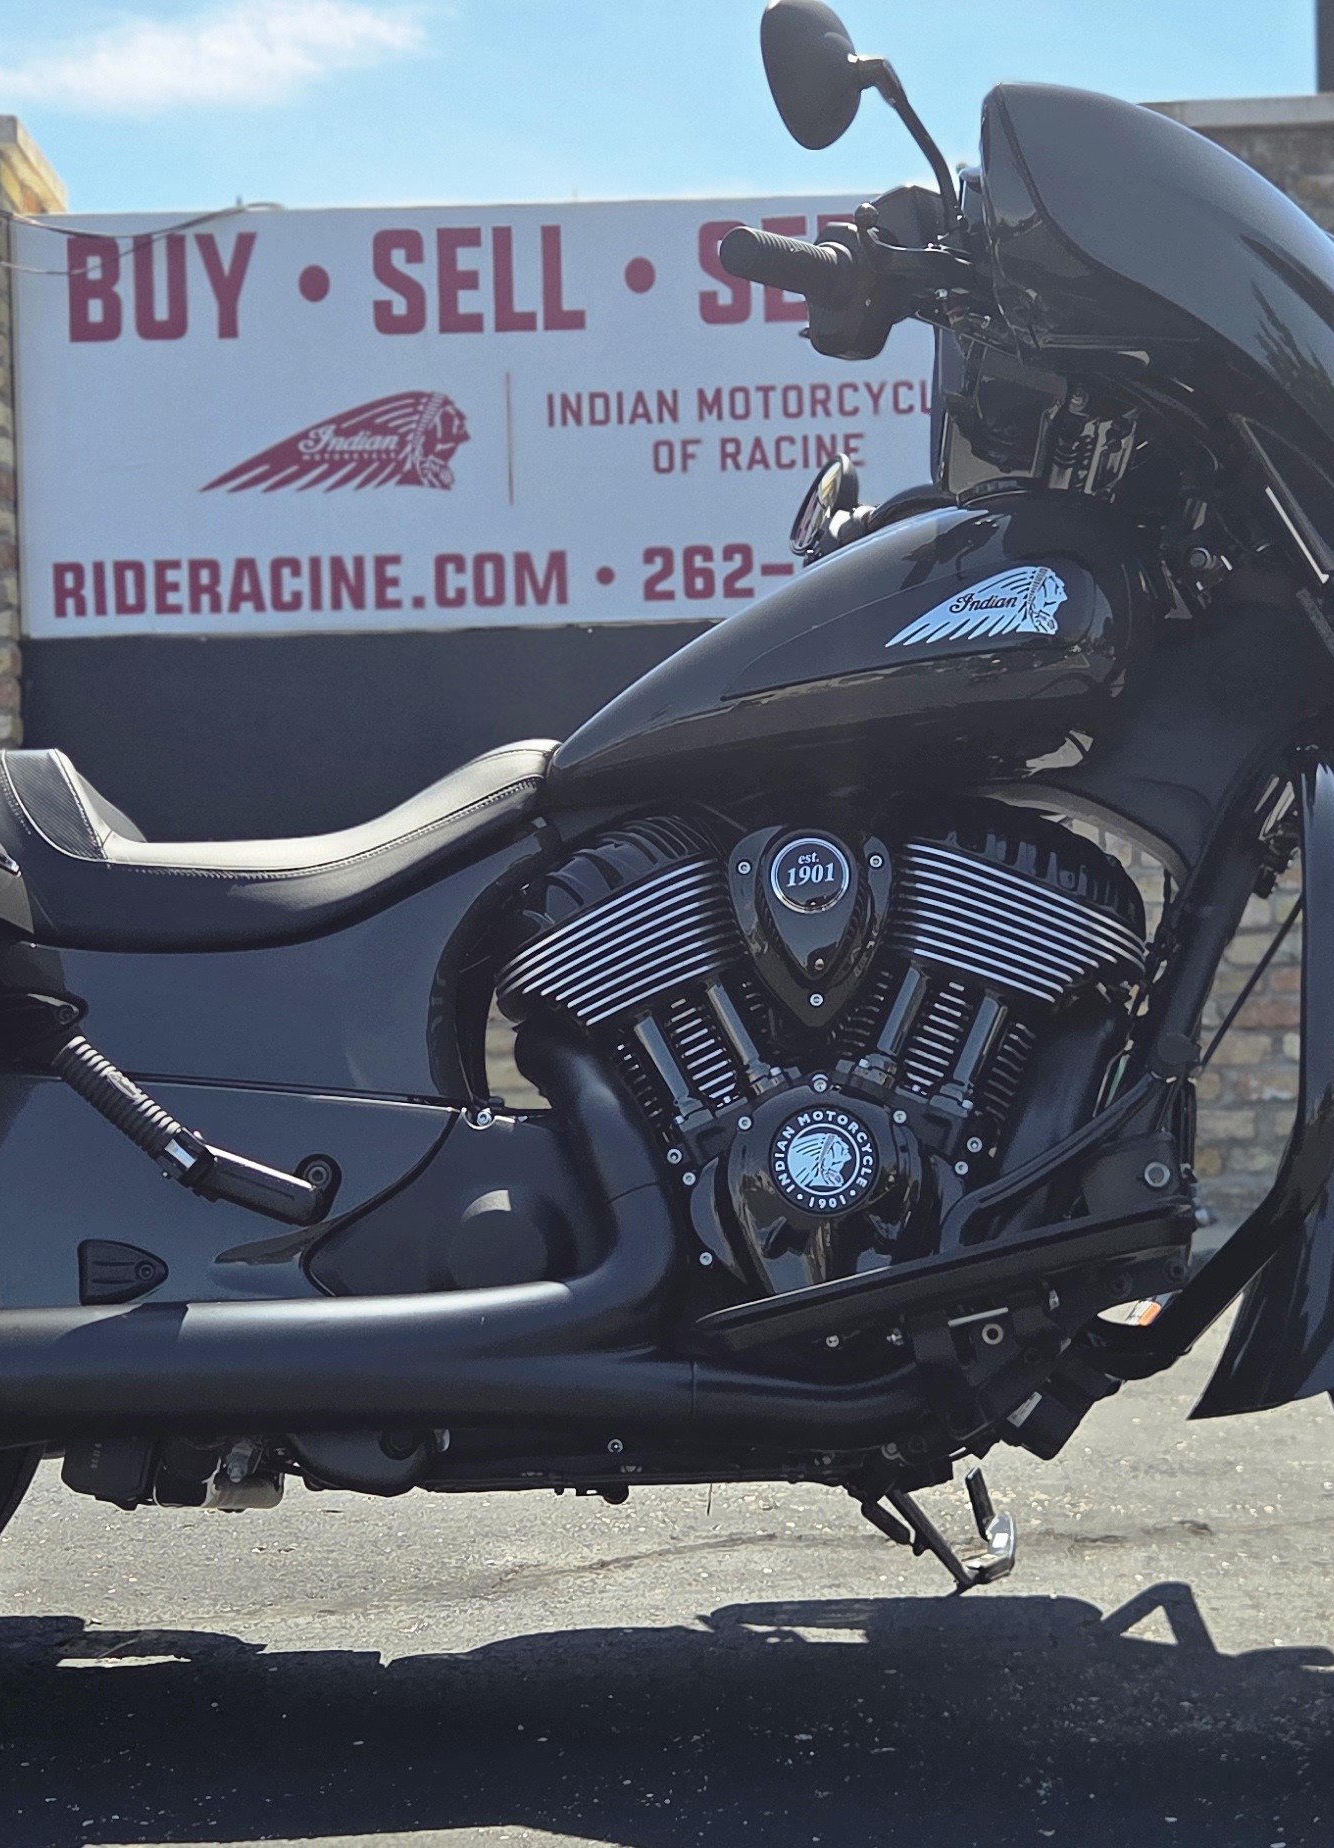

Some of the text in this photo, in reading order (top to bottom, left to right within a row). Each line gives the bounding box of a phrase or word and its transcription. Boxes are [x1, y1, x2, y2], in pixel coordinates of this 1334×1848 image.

[67, 231, 257, 343] BUY
[373, 224, 586, 335] SELL
[547, 388, 680, 427] INDIAN
[298, 423, 399, 453] Indian
[653, 432, 866, 474] OF RACINE
[52, 550, 569, 618] RIDERACINE.COM
[949, 593, 1018, 614] Indian
[786, 862, 835, 888] 1901
[798, 851, 820, 865] est.
[774, 1110, 874, 1193] INDIAN MOTORCYCLE
[808, 1194, 847, 1209] 1901
